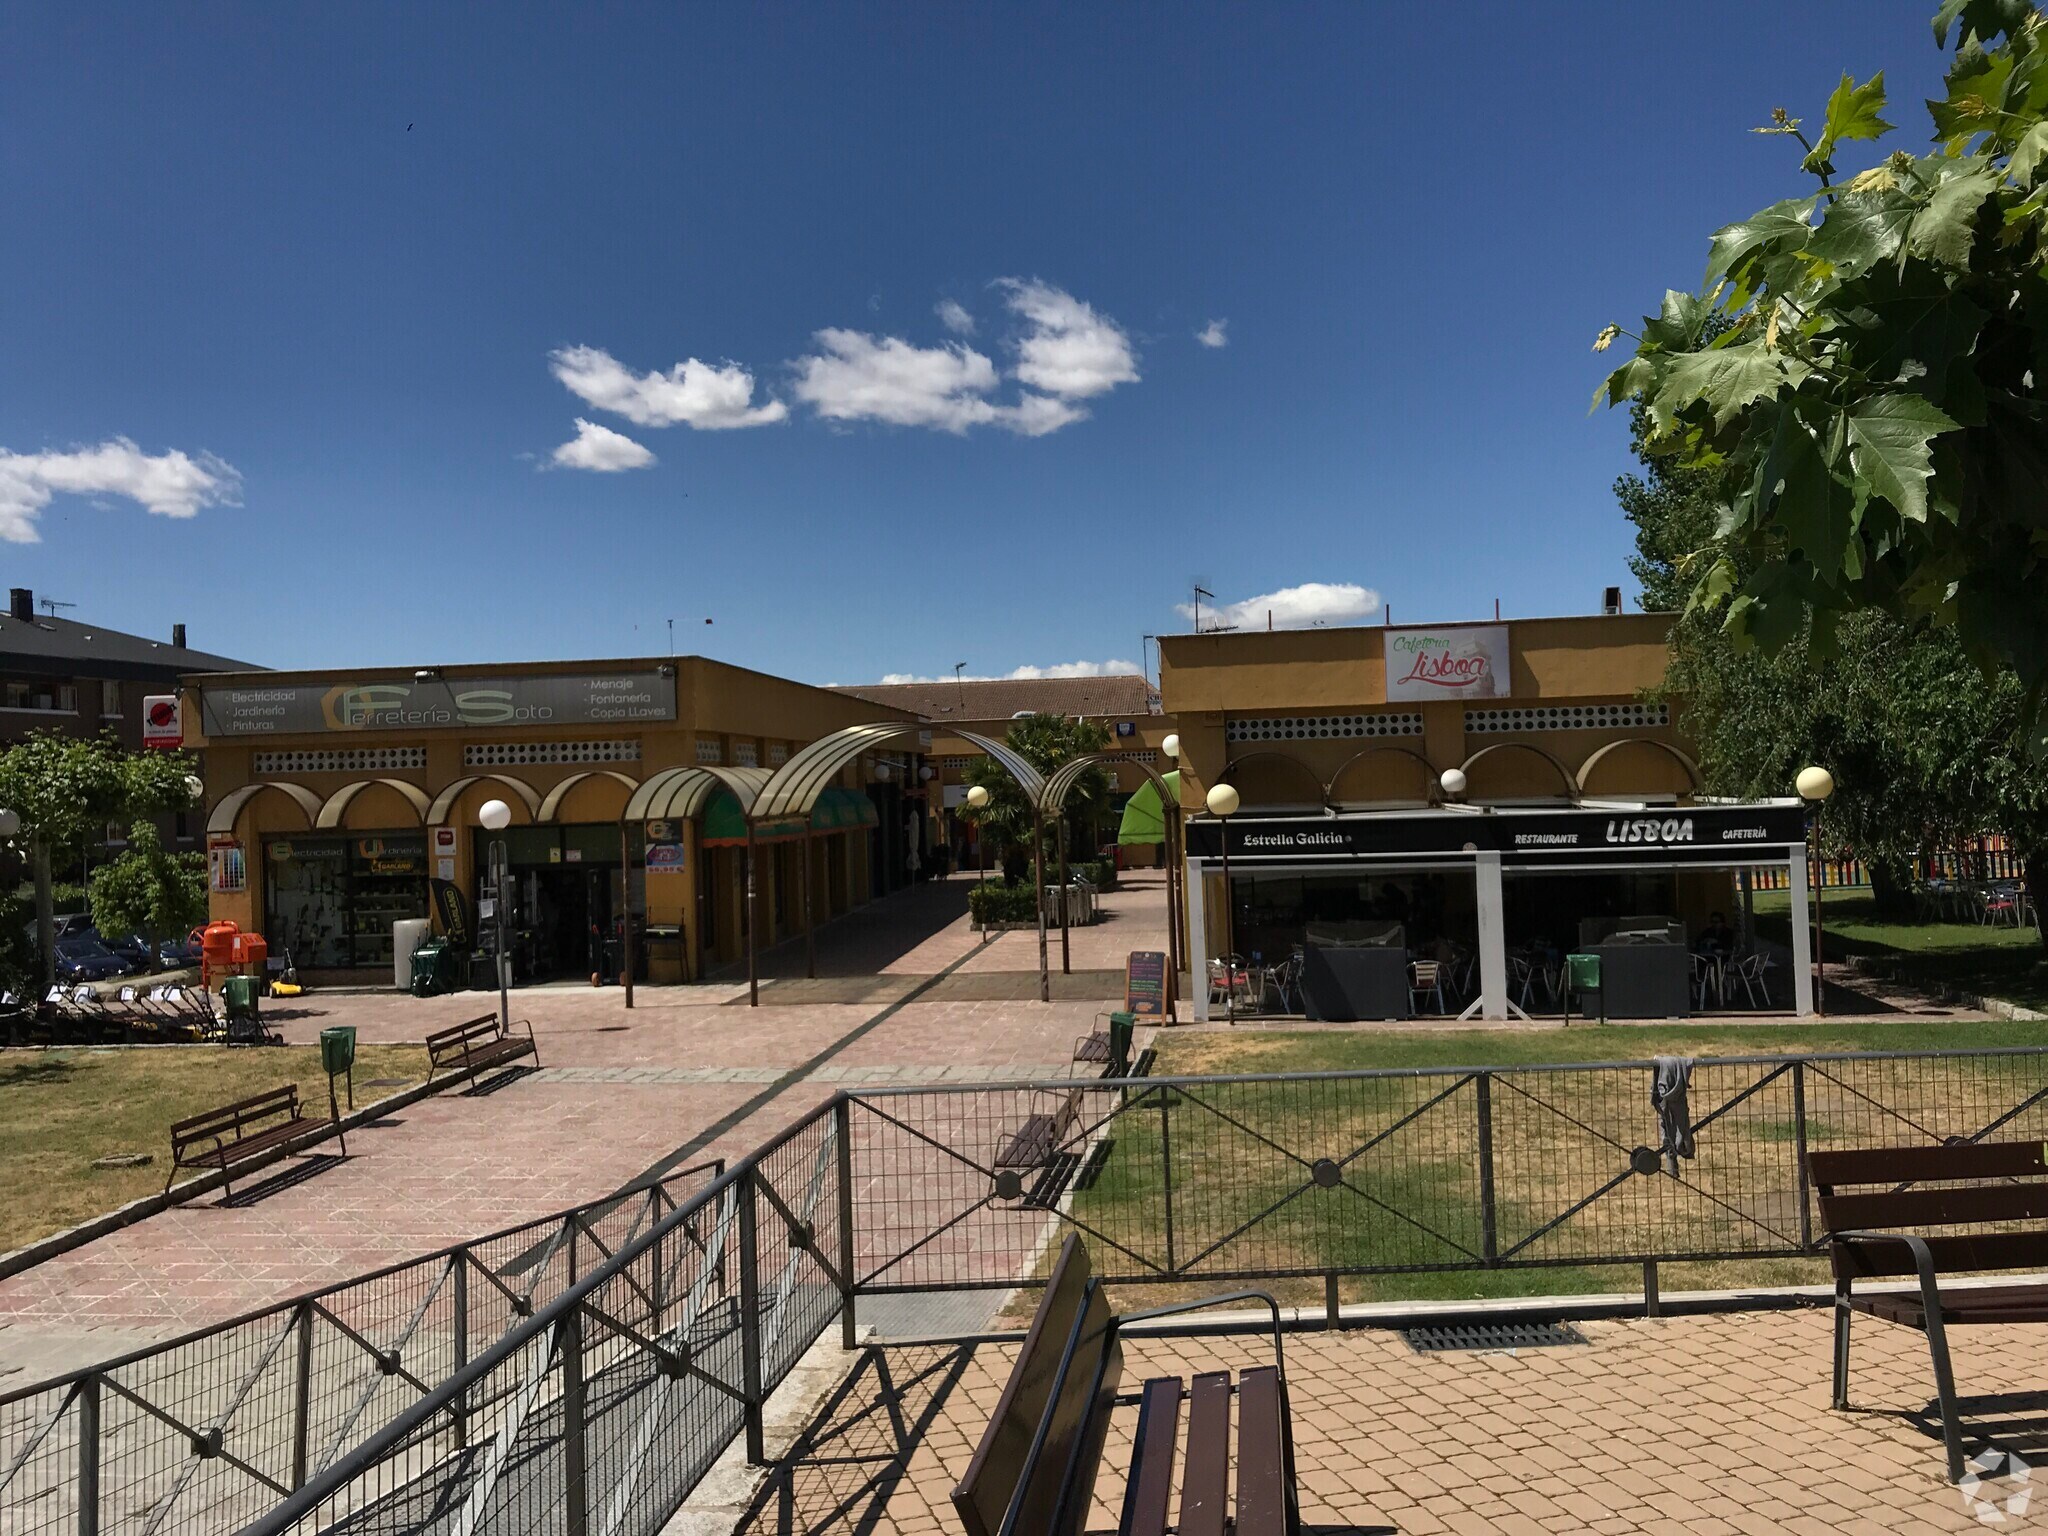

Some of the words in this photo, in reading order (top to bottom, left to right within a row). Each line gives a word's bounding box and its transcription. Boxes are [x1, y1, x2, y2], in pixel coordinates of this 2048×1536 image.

[1397, 650, 1485, 687] Lisboa
[590, 679, 633, 690] Menaje
[232, 690, 296, 703] Electricidad
[590, 692, 651, 704] Fontanería
[343, 685, 451, 726] Ferretería
[455, 690, 552, 724] Soto
[590, 708, 626, 719] Copia
[232, 719, 275, 731] Pinturas
[1515, 834, 1579, 845] RESTAURANTE
[1606, 818, 1693, 843] LISBOA
[1722, 826, 1767, 840] CAFETERÍA
[1243, 833, 1294, 846] Estrella
[1296, 832, 1343, 845] Galicia
